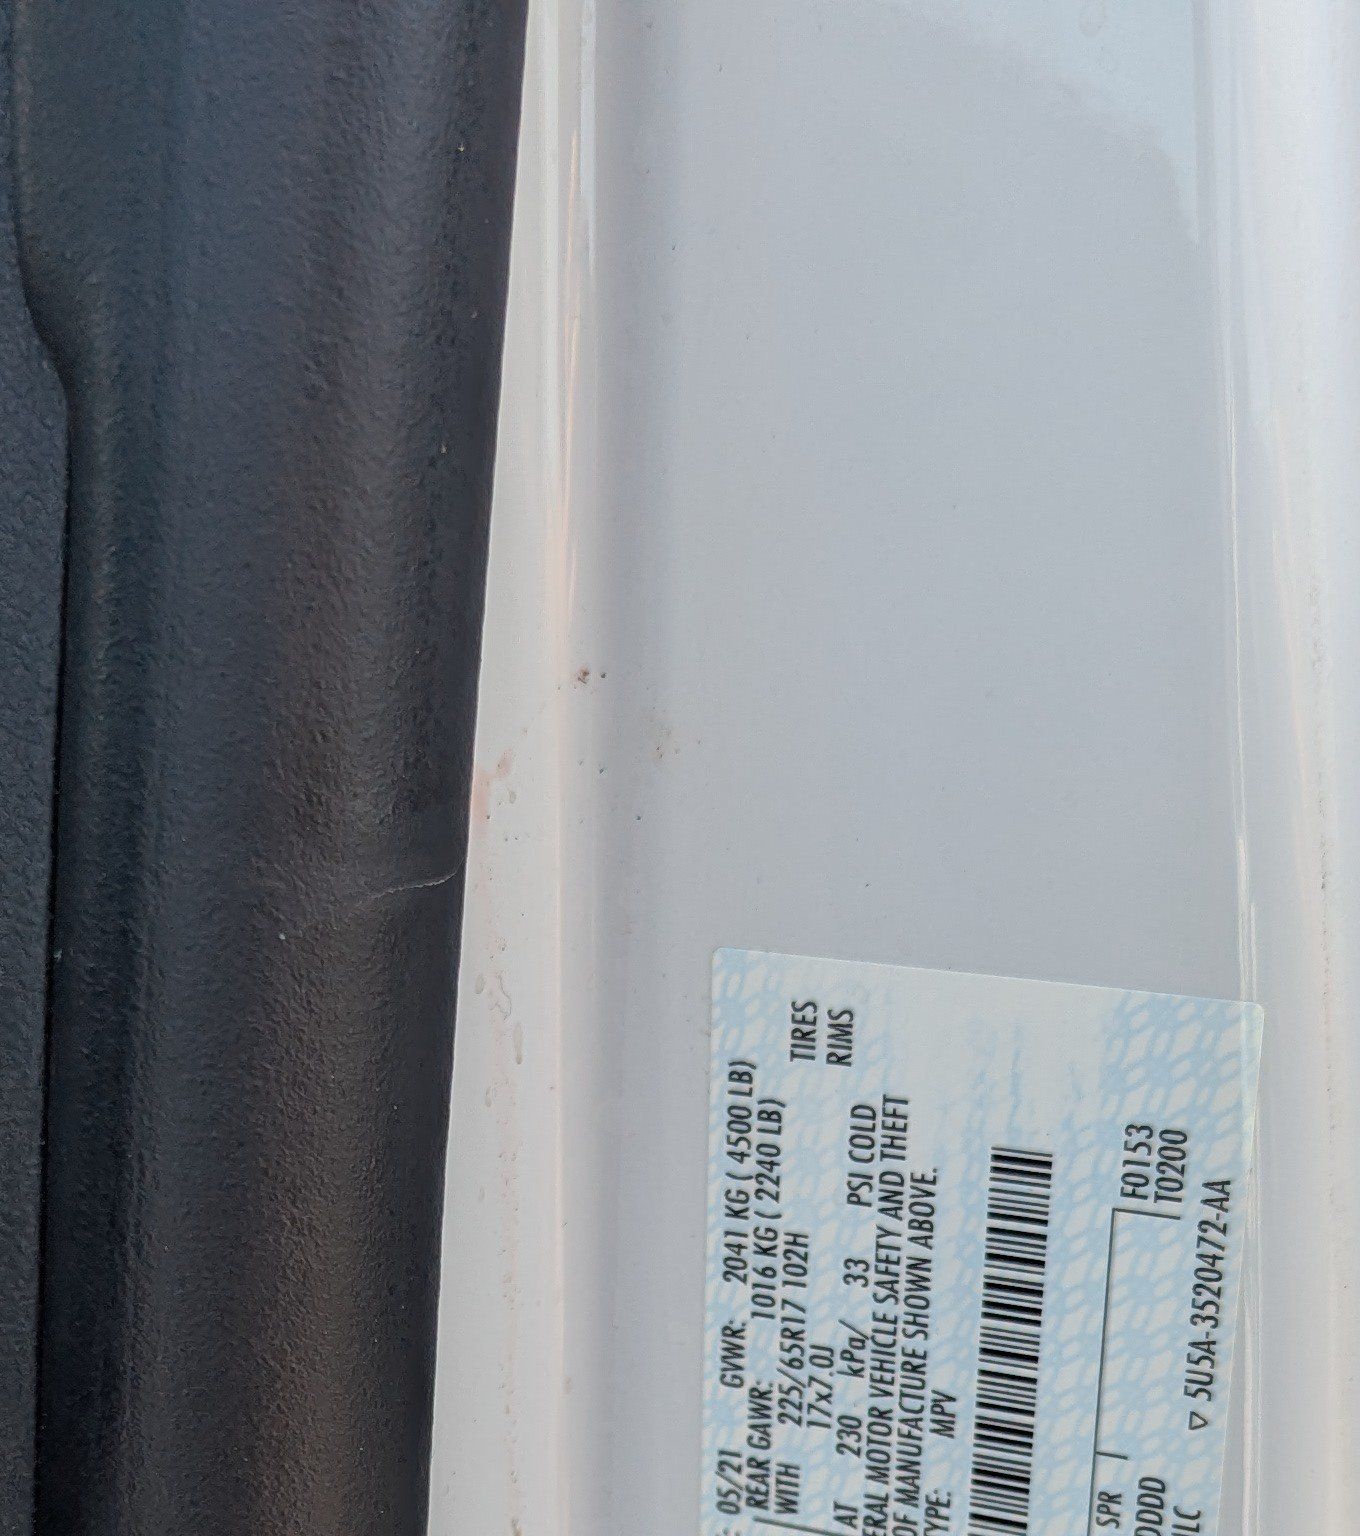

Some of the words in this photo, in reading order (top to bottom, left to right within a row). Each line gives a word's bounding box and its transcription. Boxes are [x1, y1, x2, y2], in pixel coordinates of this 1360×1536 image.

[788, 999, 818, 1062] TIRES
[824, 1008, 855, 1067] RIMS
[726, 1059, 756, 1098] LB)
[725, 1103, 753, 1164] 4500
[755, 1097, 786, 1136] LB)
[846, 1102, 877, 1164] COLD
[878, 1092, 908, 1162] THEFT
[752, 1141, 781, 1203] 2240
[845, 1170, 874, 1208] PSI
[1119, 1122, 1154, 1201] F0153
[1152, 1127, 1188, 1203] T0200
[723, 1187, 750, 1221] KG
[876, 1169, 905, 1221] AND
[906, 1166, 937, 1251] ABOVE.
[721, 1229, 749, 1285] 2041
[751, 1225, 779, 1258] KG
[781, 1231, 809, 1288] 102H
[841, 1256, 871, 1288] 33
[870, 1224, 902, 1305] SAFETY
[749, 1264, 778, 1320] 1016
[900, 1255, 932, 1341] SHOWN
[1182, 1178, 1232, 1402] 5U5A-3520472-AA
[718, 1318, 746, 1389] GVWR:
[776, 1297, 807, 1427] 225/65R17
[836, 1318, 869, 1379] kPa/
[866, 1310, 898, 1398] VEHICLE
[745, 1379, 773, 1451] GAWR:
[805, 1343, 835, 1429] 17x7.0J
[928, 1388, 957, 1439] MPV
[834, 1413, 863, 1458] 230
[864, 1404, 894, 1486] MOTOR
[893, 1345, 928, 1509] MANUFACTURE
[714, 1447, 743, 1516] 05/21
[744, 1454, 771, 1511] REAR
[773, 1461, 801, 1514] WITH
[1094, 1489, 1123, 1529] SPR
[832, 1499, 859, 1530] AT
